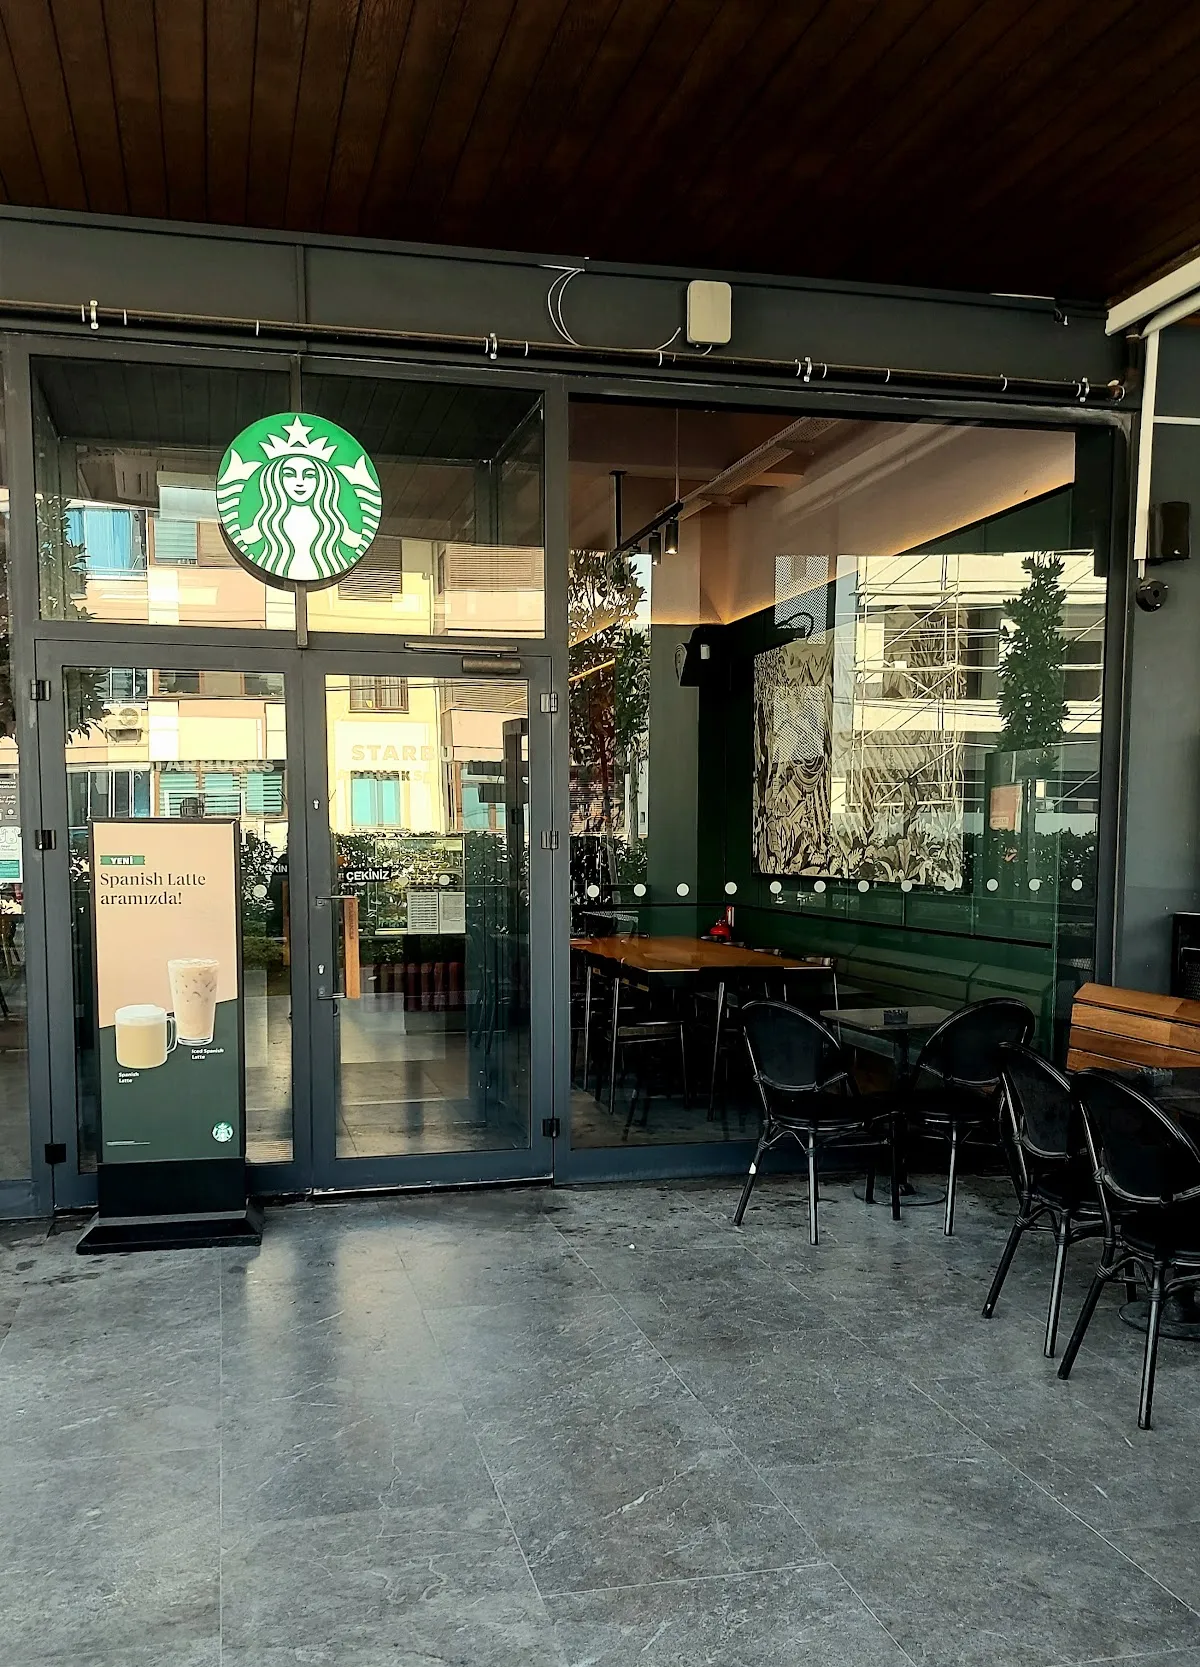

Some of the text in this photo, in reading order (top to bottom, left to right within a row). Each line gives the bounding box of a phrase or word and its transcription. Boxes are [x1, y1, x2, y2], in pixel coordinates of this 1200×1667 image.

[110, 855, 134, 865] YENİ
[100, 872, 206, 888] Spanish Latte
[346, 867, 390, 883] ÇEKİNİZ
[100, 891, 182, 905] aramızda!
